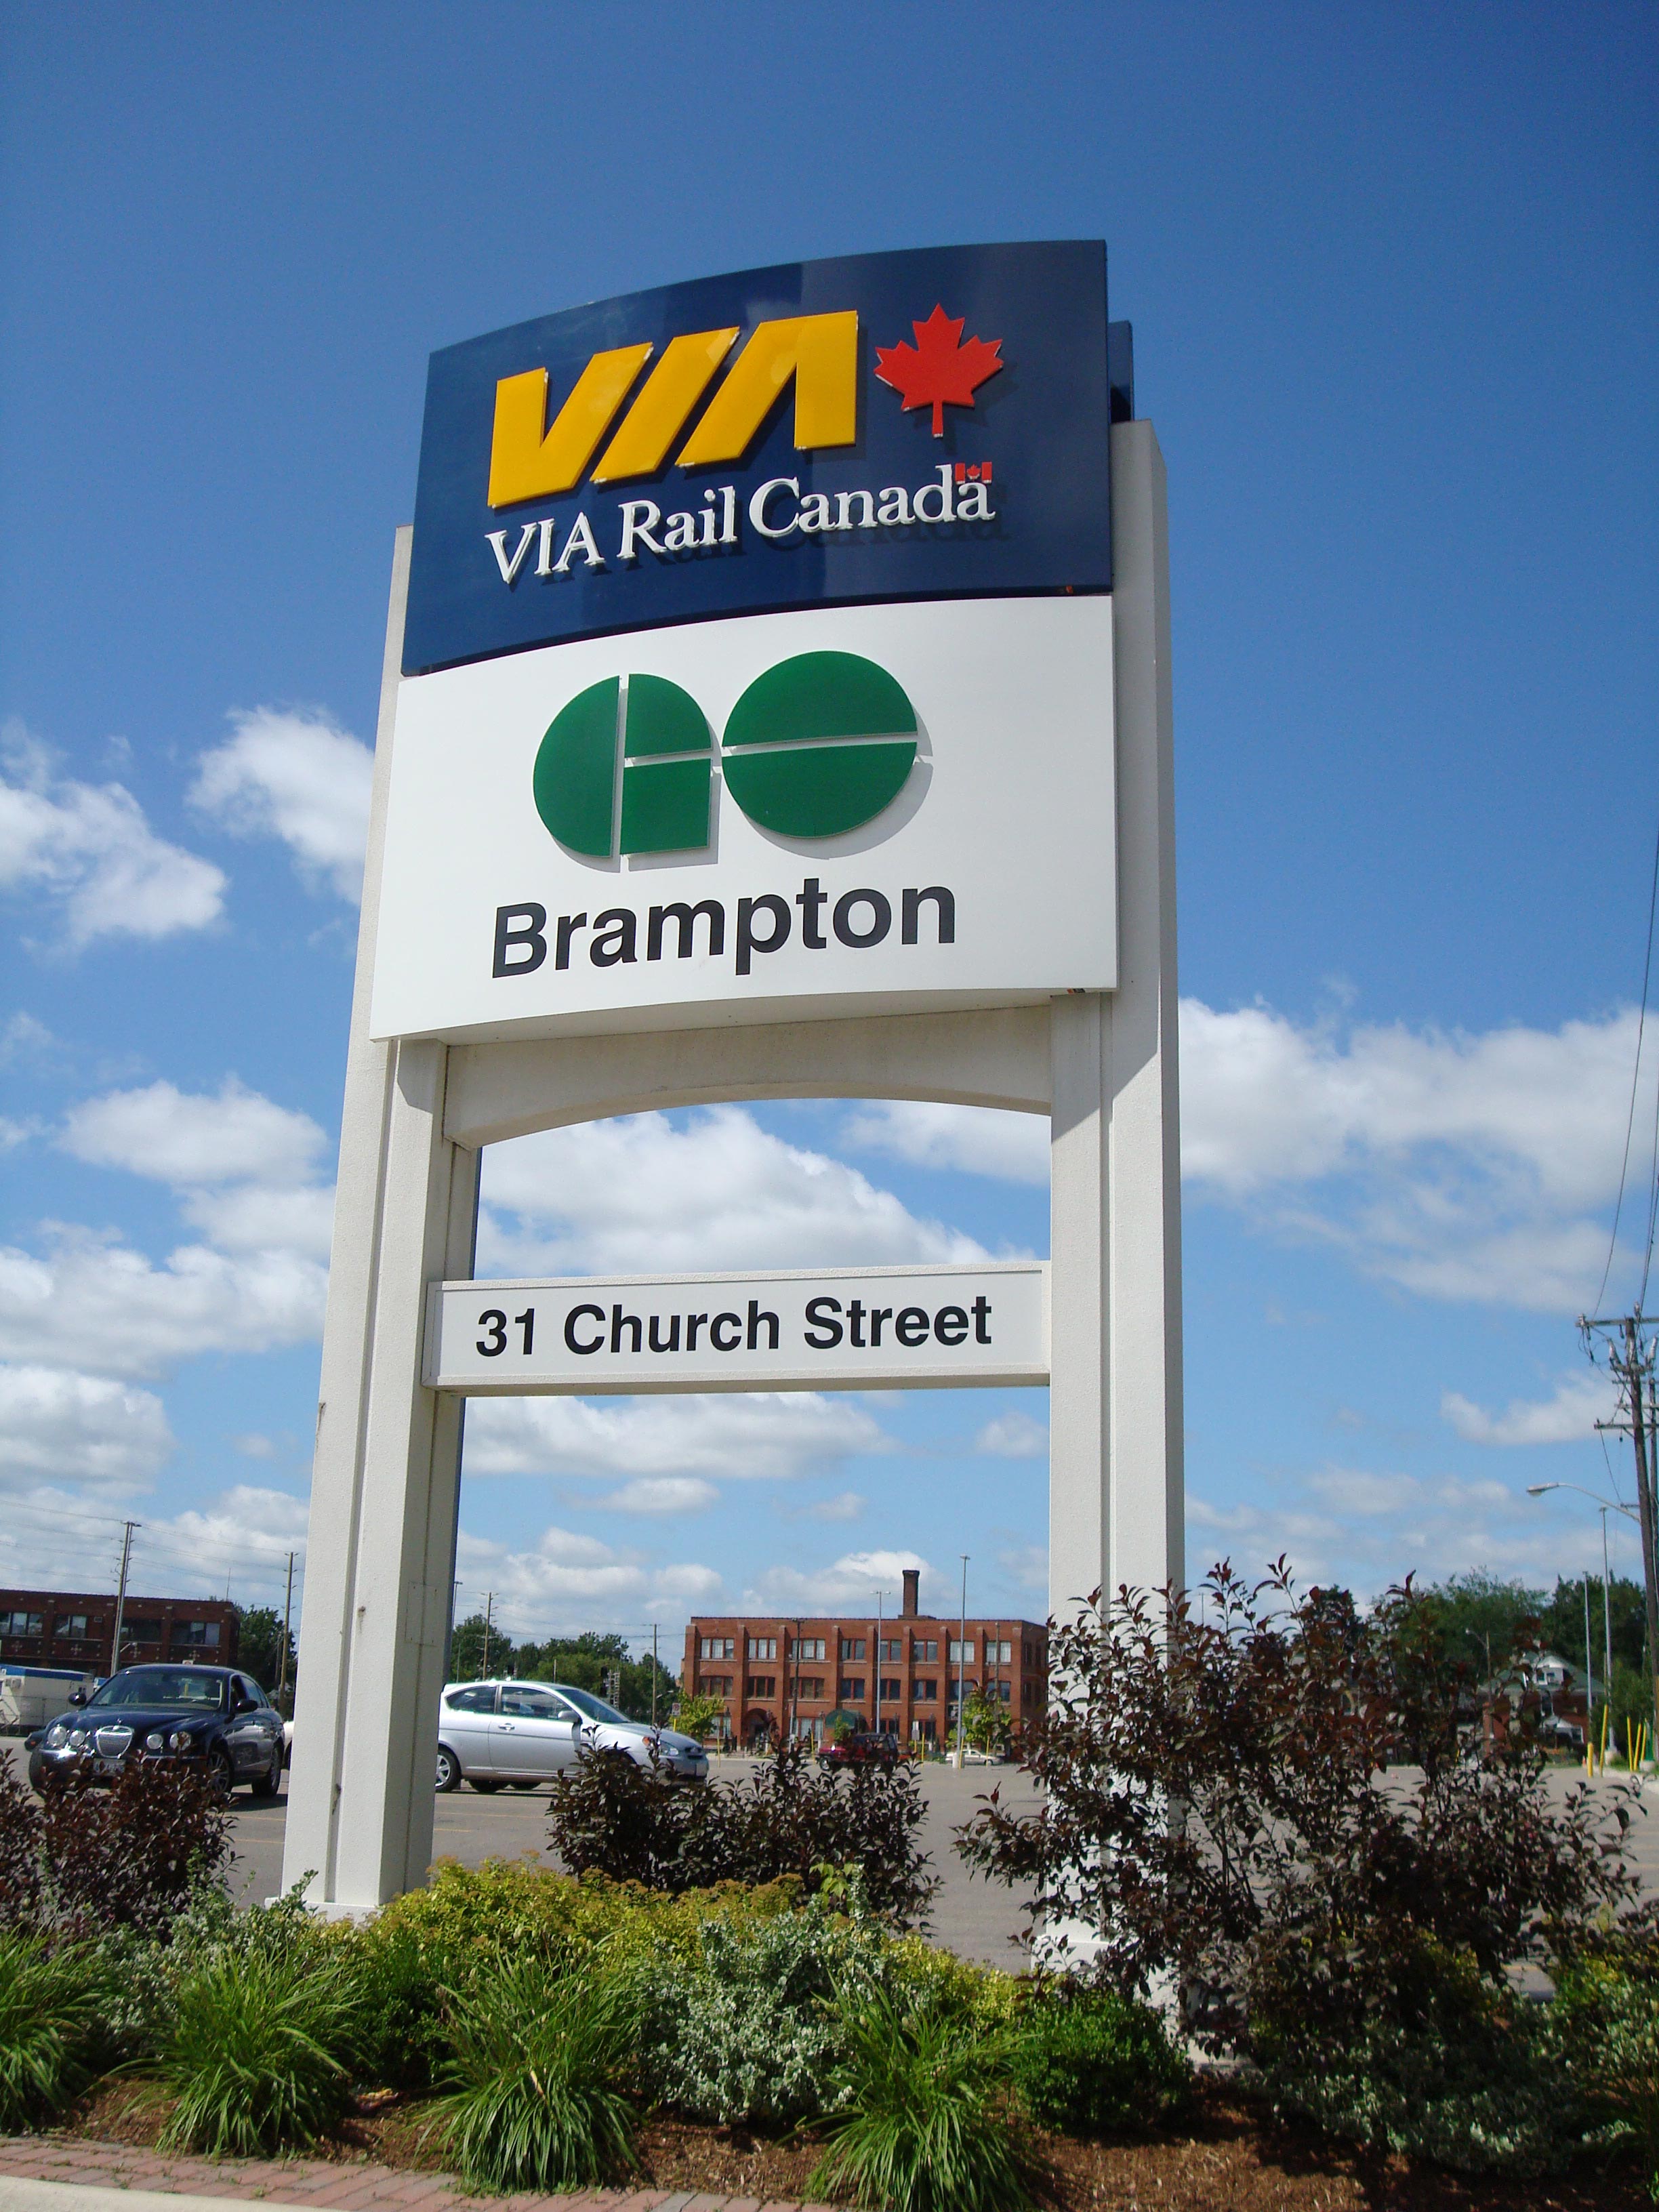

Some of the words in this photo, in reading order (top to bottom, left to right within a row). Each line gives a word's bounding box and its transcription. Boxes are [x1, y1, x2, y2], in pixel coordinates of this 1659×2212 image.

[487, 310, 858, 508] VIA
[485, 512, 605, 584] VIA
[616, 485, 737, 559] Rail
[749, 464, 996, 535] Canada
[492, 878, 955, 979] Brampton
[476, 1308, 535, 1357] 31
[564, 1300, 779, 1355] Church
[804, 1296, 992, 1349] Street
